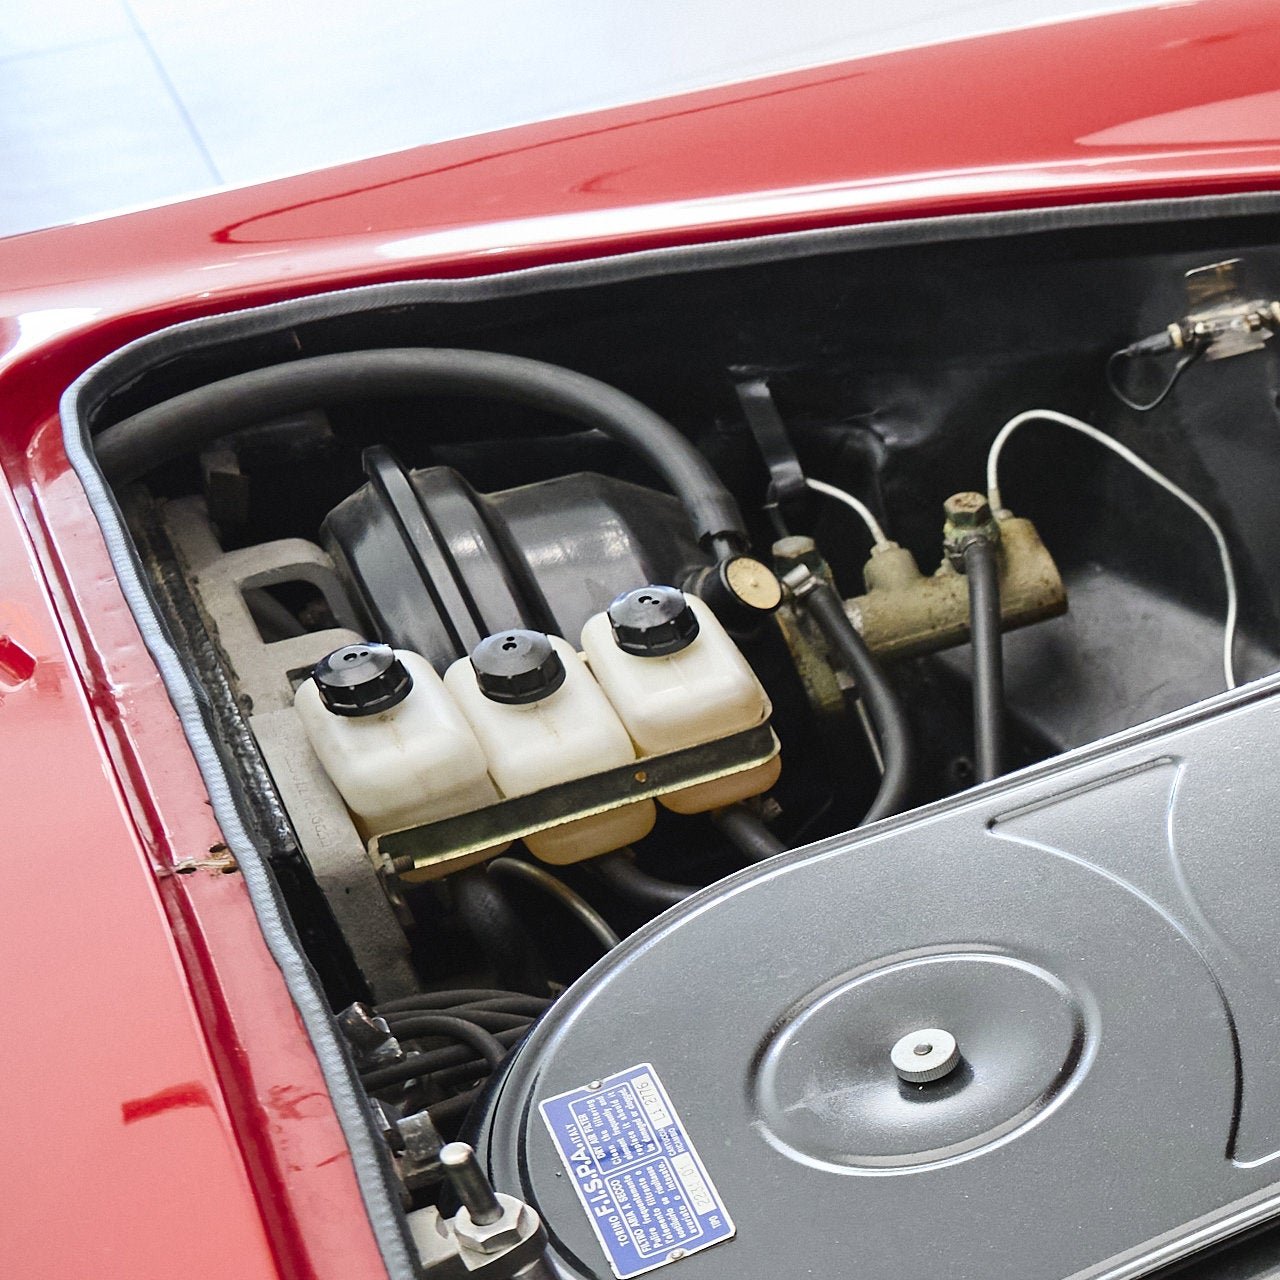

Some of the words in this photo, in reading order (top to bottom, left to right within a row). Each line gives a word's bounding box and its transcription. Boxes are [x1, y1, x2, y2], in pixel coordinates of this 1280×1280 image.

[583, 1097, 606, 1127] filtering
[595, 1094, 608, 1107] and
[564, 1121, 582, 1144] ITALY
[576, 1112, 593, 1134] FILTER
[600, 1106, 623, 1136] frequently
[586, 1132, 599, 1145] AIR
[598, 1128, 611, 1142] the
[625, 1129, 645, 1157] replace
[592, 1144, 606, 1160] DRY
[605, 1143, 622, 1165] Clean
[615, 1136, 634, 1161] element
[608, 1178, 628, 1203] SECCO
[621, 1173, 654, 1225] frequentemente
[635, 1176, 657, 1207] filtrante
[620, 1202, 632, 1211] A
[607, 1214, 630, 1247] TORINO
[623, 1209, 640, 1229] ARIA
[675, 1204, 698, 1235] avariato
[707, 1214, 722, 1229] TIPO
[632, 1227, 652, 1253] FILTRO
[645, 1226, 664, 1249] Pulire
